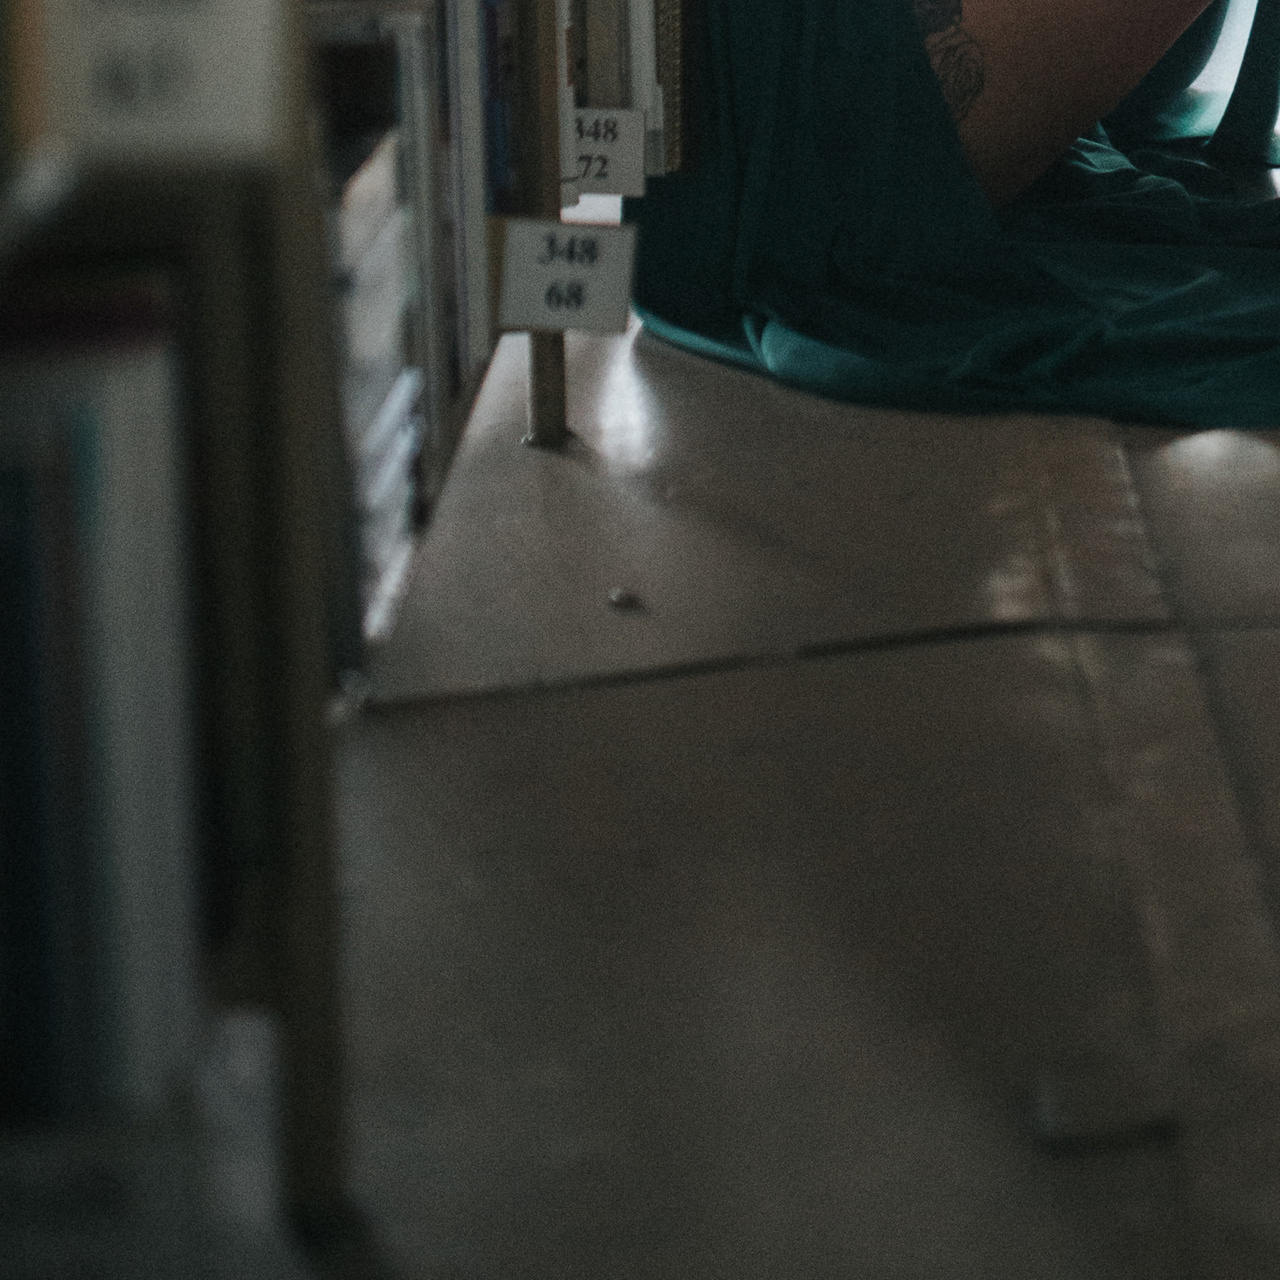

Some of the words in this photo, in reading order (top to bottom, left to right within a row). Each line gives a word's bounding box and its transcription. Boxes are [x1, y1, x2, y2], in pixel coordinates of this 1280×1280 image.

[579, 154, 608, 178] 72
[539, 233, 598, 265] 348
[545, 282, 584, 311] 68
